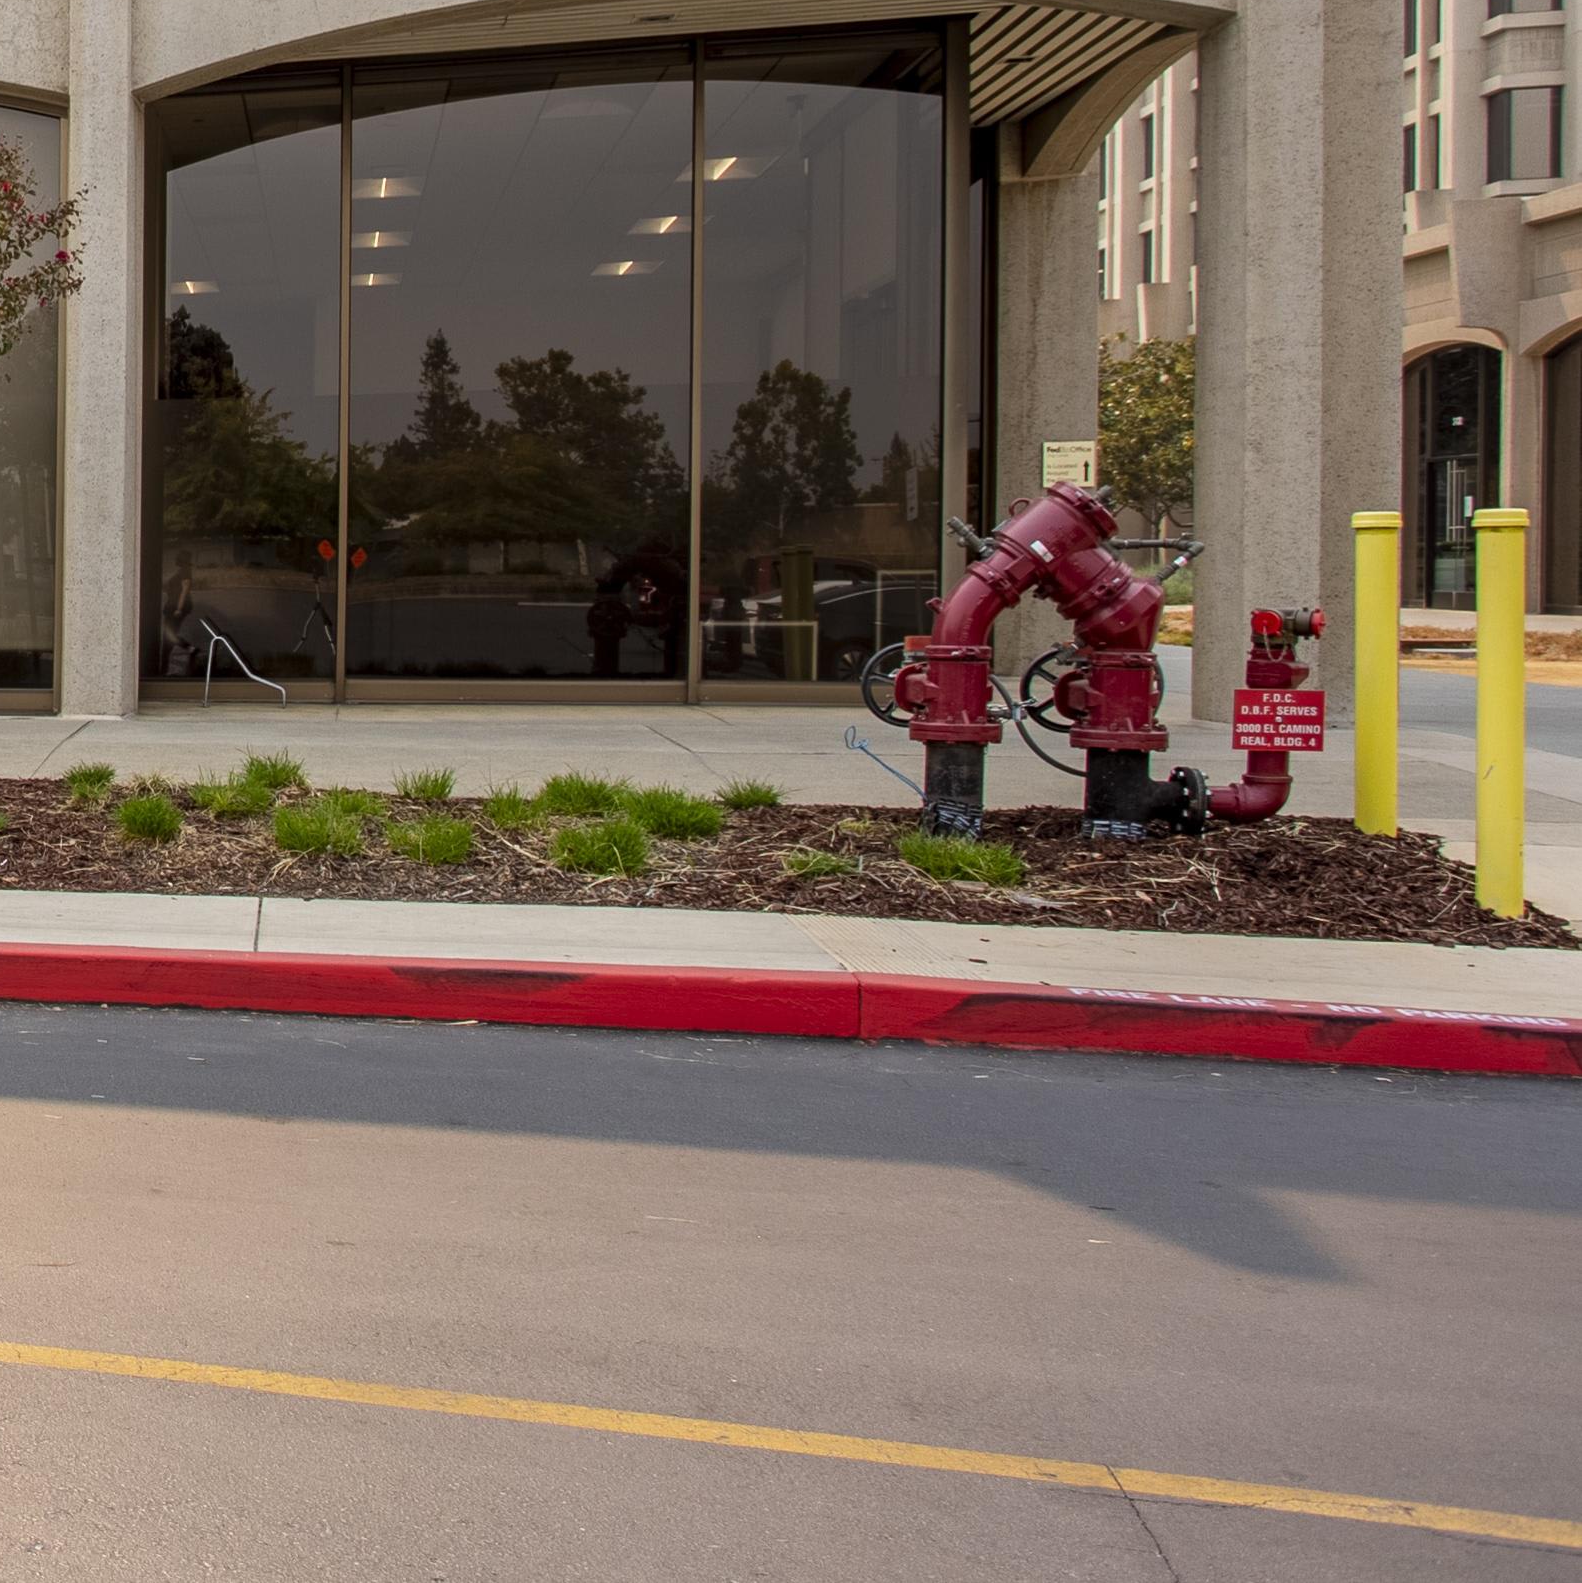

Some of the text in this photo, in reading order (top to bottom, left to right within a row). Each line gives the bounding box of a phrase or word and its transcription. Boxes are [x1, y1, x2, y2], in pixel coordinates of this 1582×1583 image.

[1262, 693, 1296, 703] F.D.C.
[1241, 705, 1318, 716] D.B.F. SERVES
[1236, 724, 1321, 734] 3000 EL CAMINO
[1240, 736, 1316, 747] REAL, BLDG. 4
[1067, 987, 1158, 1001] FIRE
[1170, 994, 1273, 1009] LANE
[1329, 1003, 1382, 1016] NO
[1396, 1008, 1569, 1027] PARKING
